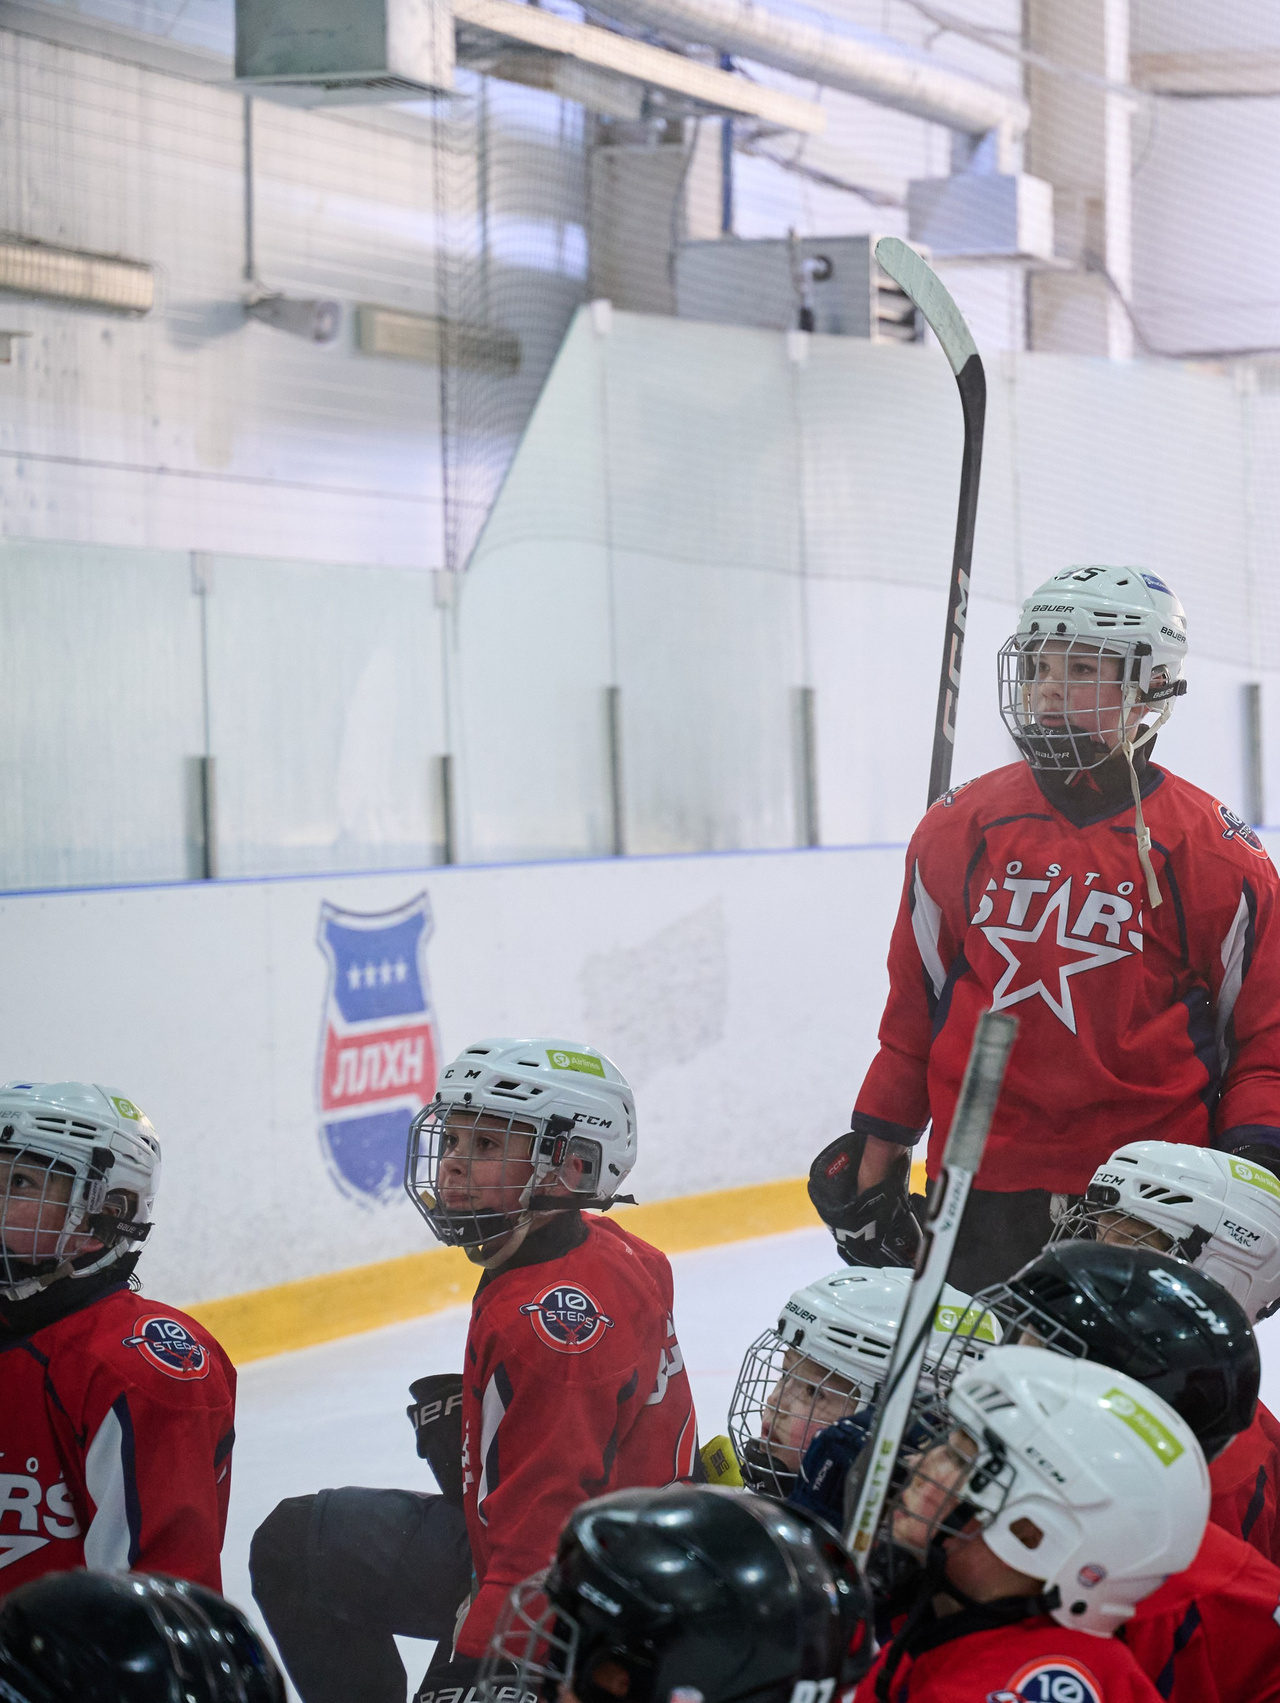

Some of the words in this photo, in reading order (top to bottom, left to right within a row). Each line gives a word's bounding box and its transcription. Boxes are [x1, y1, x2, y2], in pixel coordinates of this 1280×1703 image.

[1031, 604, 1075, 613] BAUER
[1160, 626, 1187, 643] BAUER
[1006, 860, 1135, 896] OSTO
[444, 1069, 482, 1080] CM
[573, 1112, 613, 1129] CCM
[828, 1155, 847, 1176] CCM
[1093, 1173, 1125, 1186] CCM
[1223, 1219, 1261, 1242] CCM
[554, 1291, 588, 1311] 10
[546, 1310, 594, 1329] STEPS
[785, 1301, 817, 1323] BAUER
[151, 1323, 187, 1340] 10
